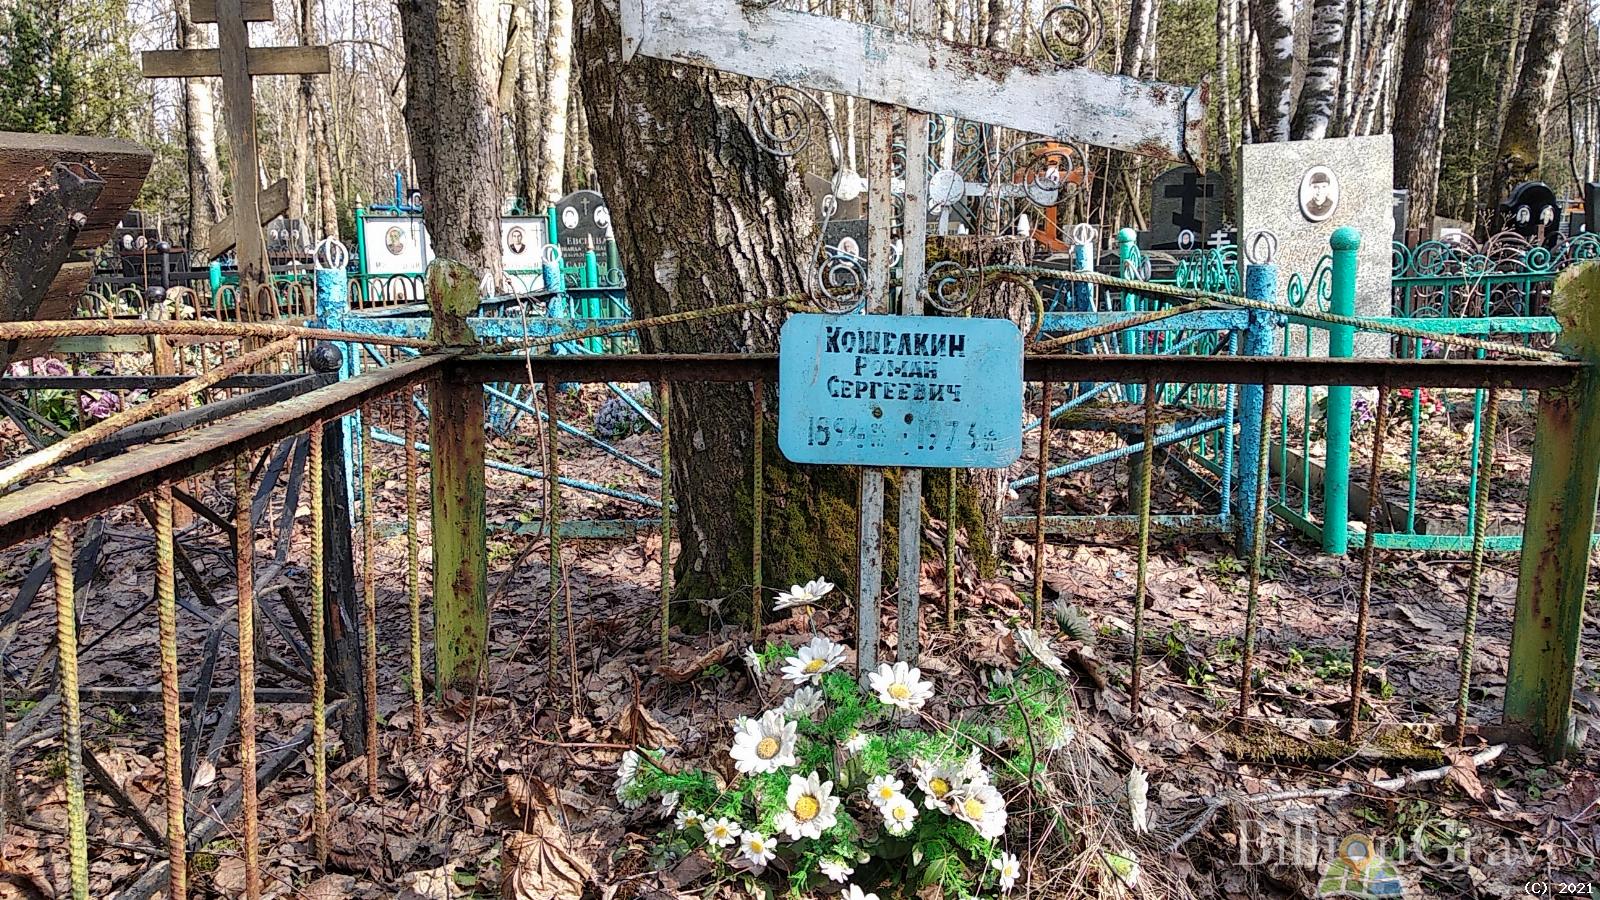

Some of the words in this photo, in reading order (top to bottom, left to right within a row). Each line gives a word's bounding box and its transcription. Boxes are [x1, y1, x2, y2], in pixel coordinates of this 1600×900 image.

[825, 326, 966, 357] КОШЕЛКИН
[853, 356, 938, 379] РОМАН
[826, 375, 962, 402] СЕРГЕЕВИЧ
